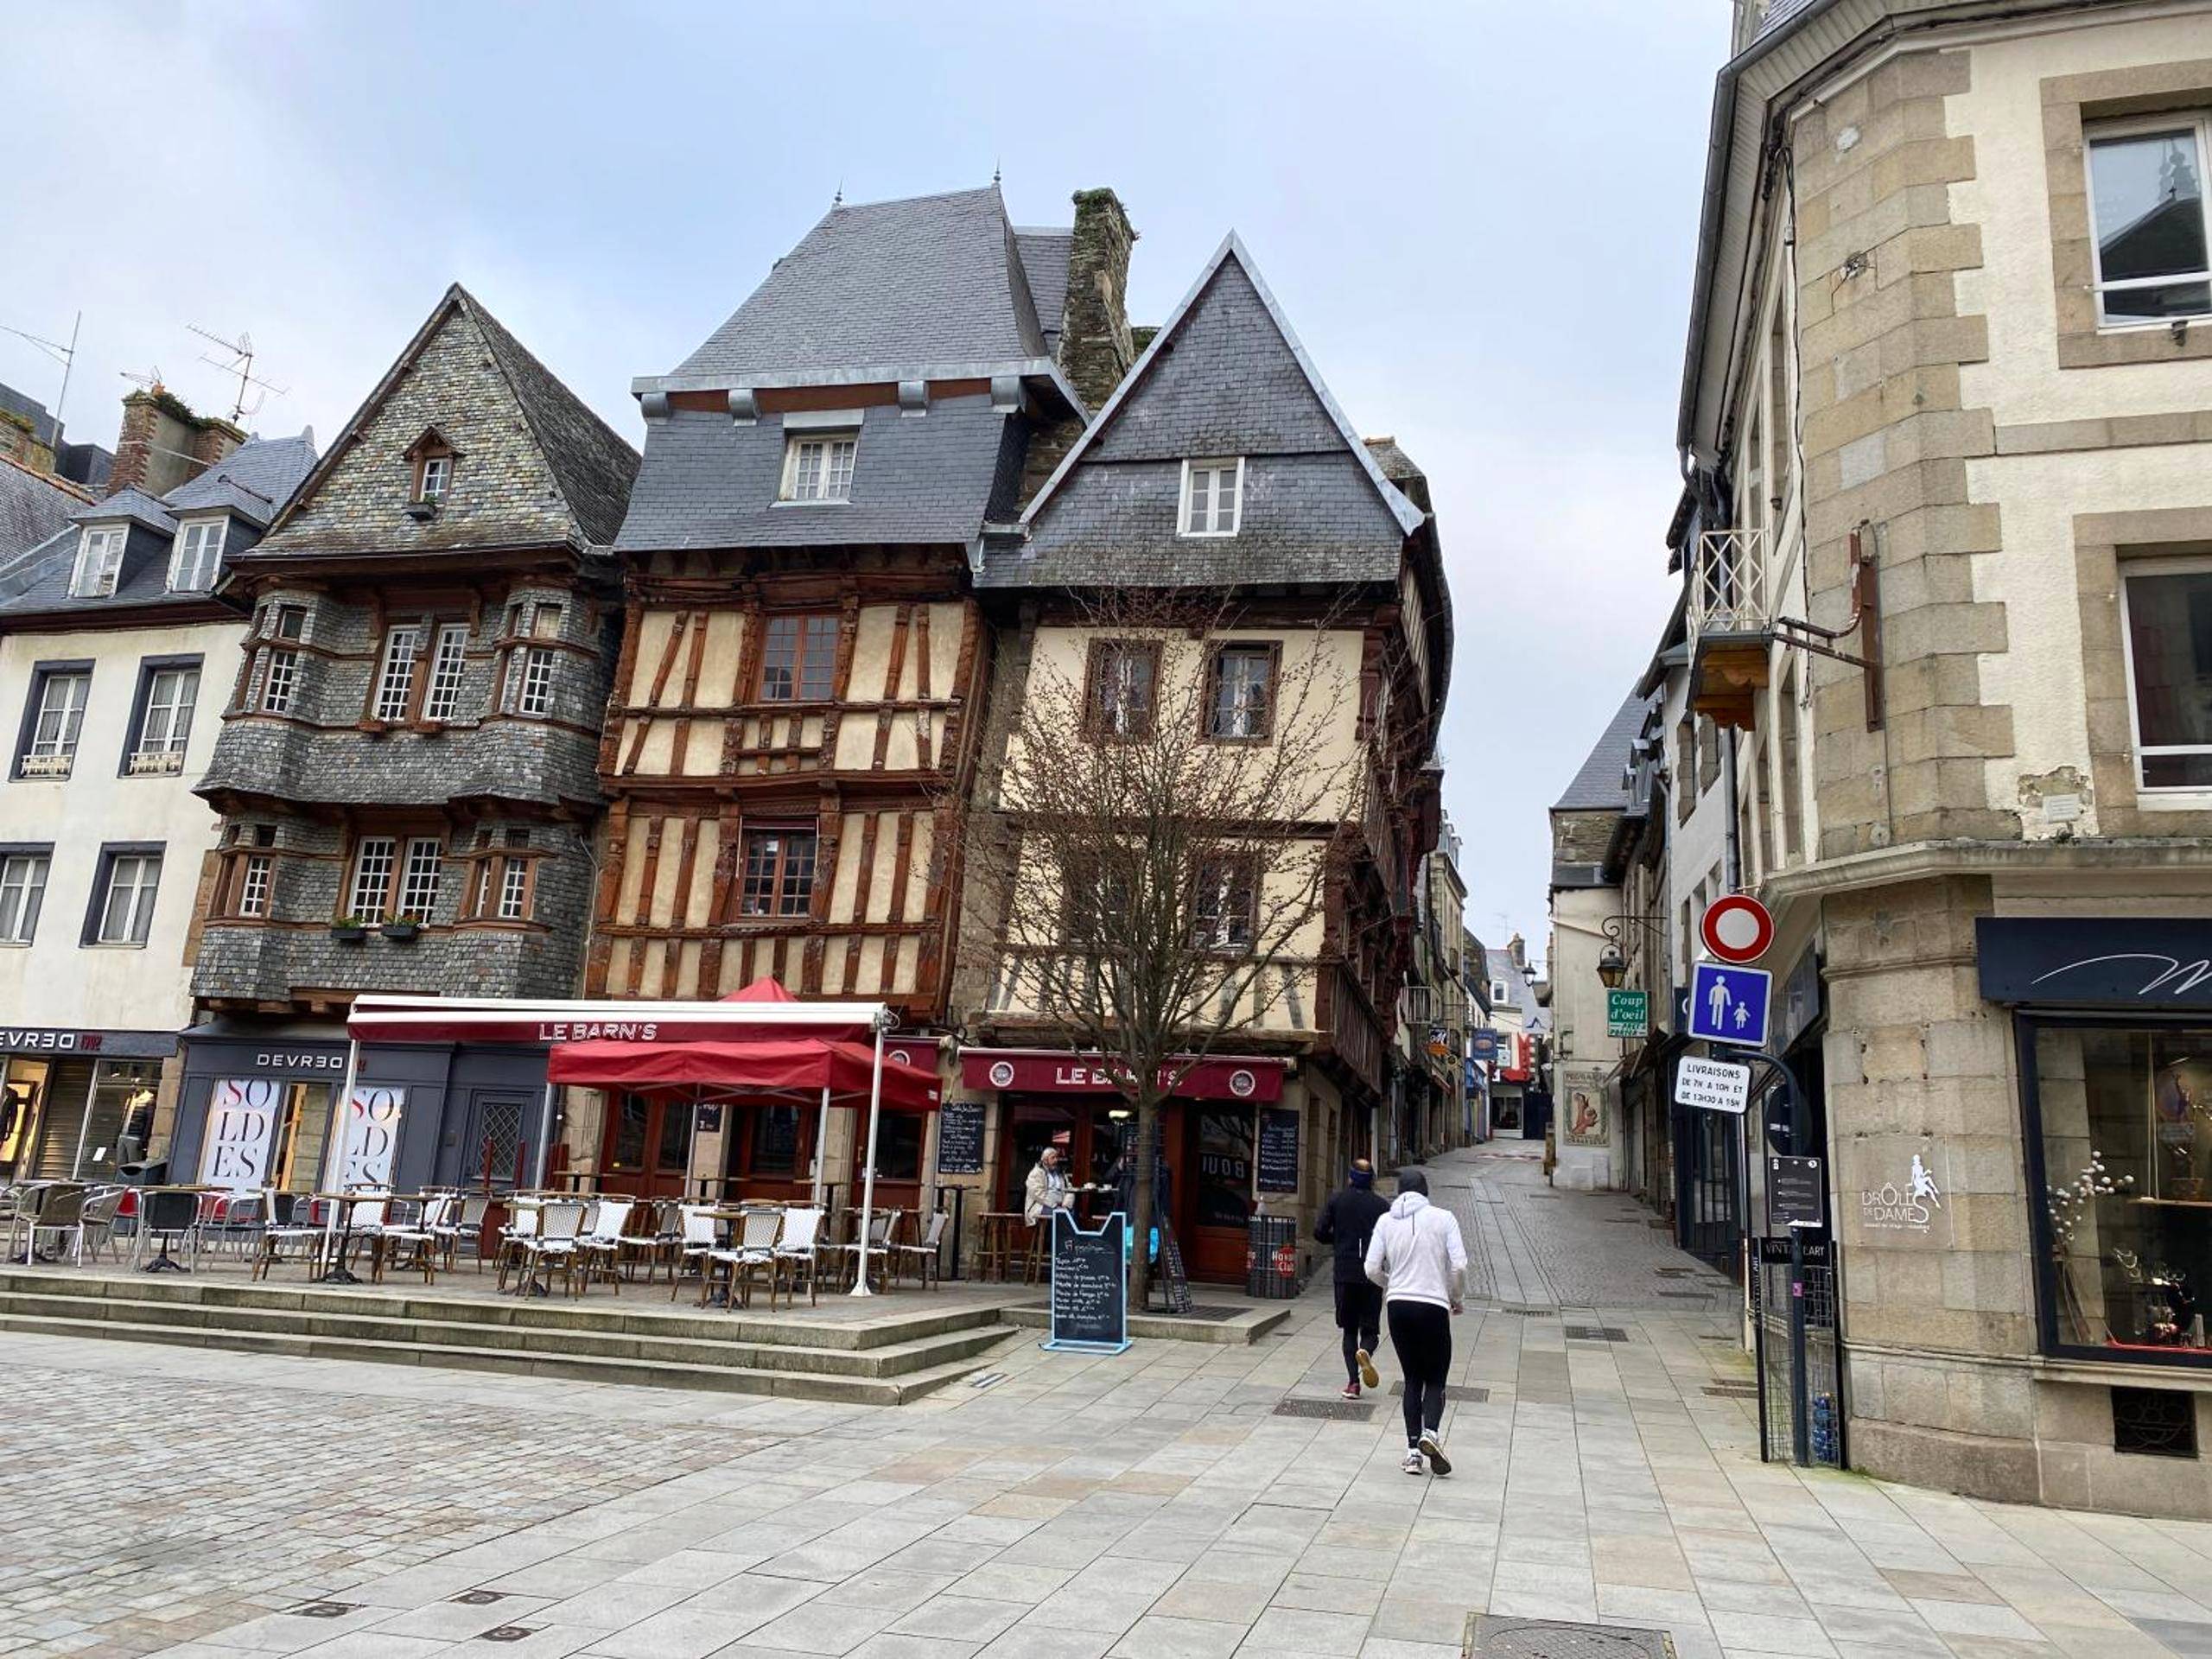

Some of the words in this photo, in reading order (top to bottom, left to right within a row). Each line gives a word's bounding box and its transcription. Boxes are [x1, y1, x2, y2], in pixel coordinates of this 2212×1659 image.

[1611, 994, 1643, 1008] Coup
[539, 1023, 568, 1041] LE
[572, 1023, 658, 1040] BARN'S
[1055, 1067, 1087, 1085] LE
[1687, 1064, 1741, 1079] LIVRAISONS
[223, 1079, 272, 1108] SO
[1682, 1077, 1690, 1086] DE
[1716, 1083, 1729, 1092] 10H
[1733, 1085, 1743, 1094] ET
[219, 1111, 264, 1142] LD
[213, 1146, 257, 1179] ES
[1874, 1205, 1929, 1224] DAMES
